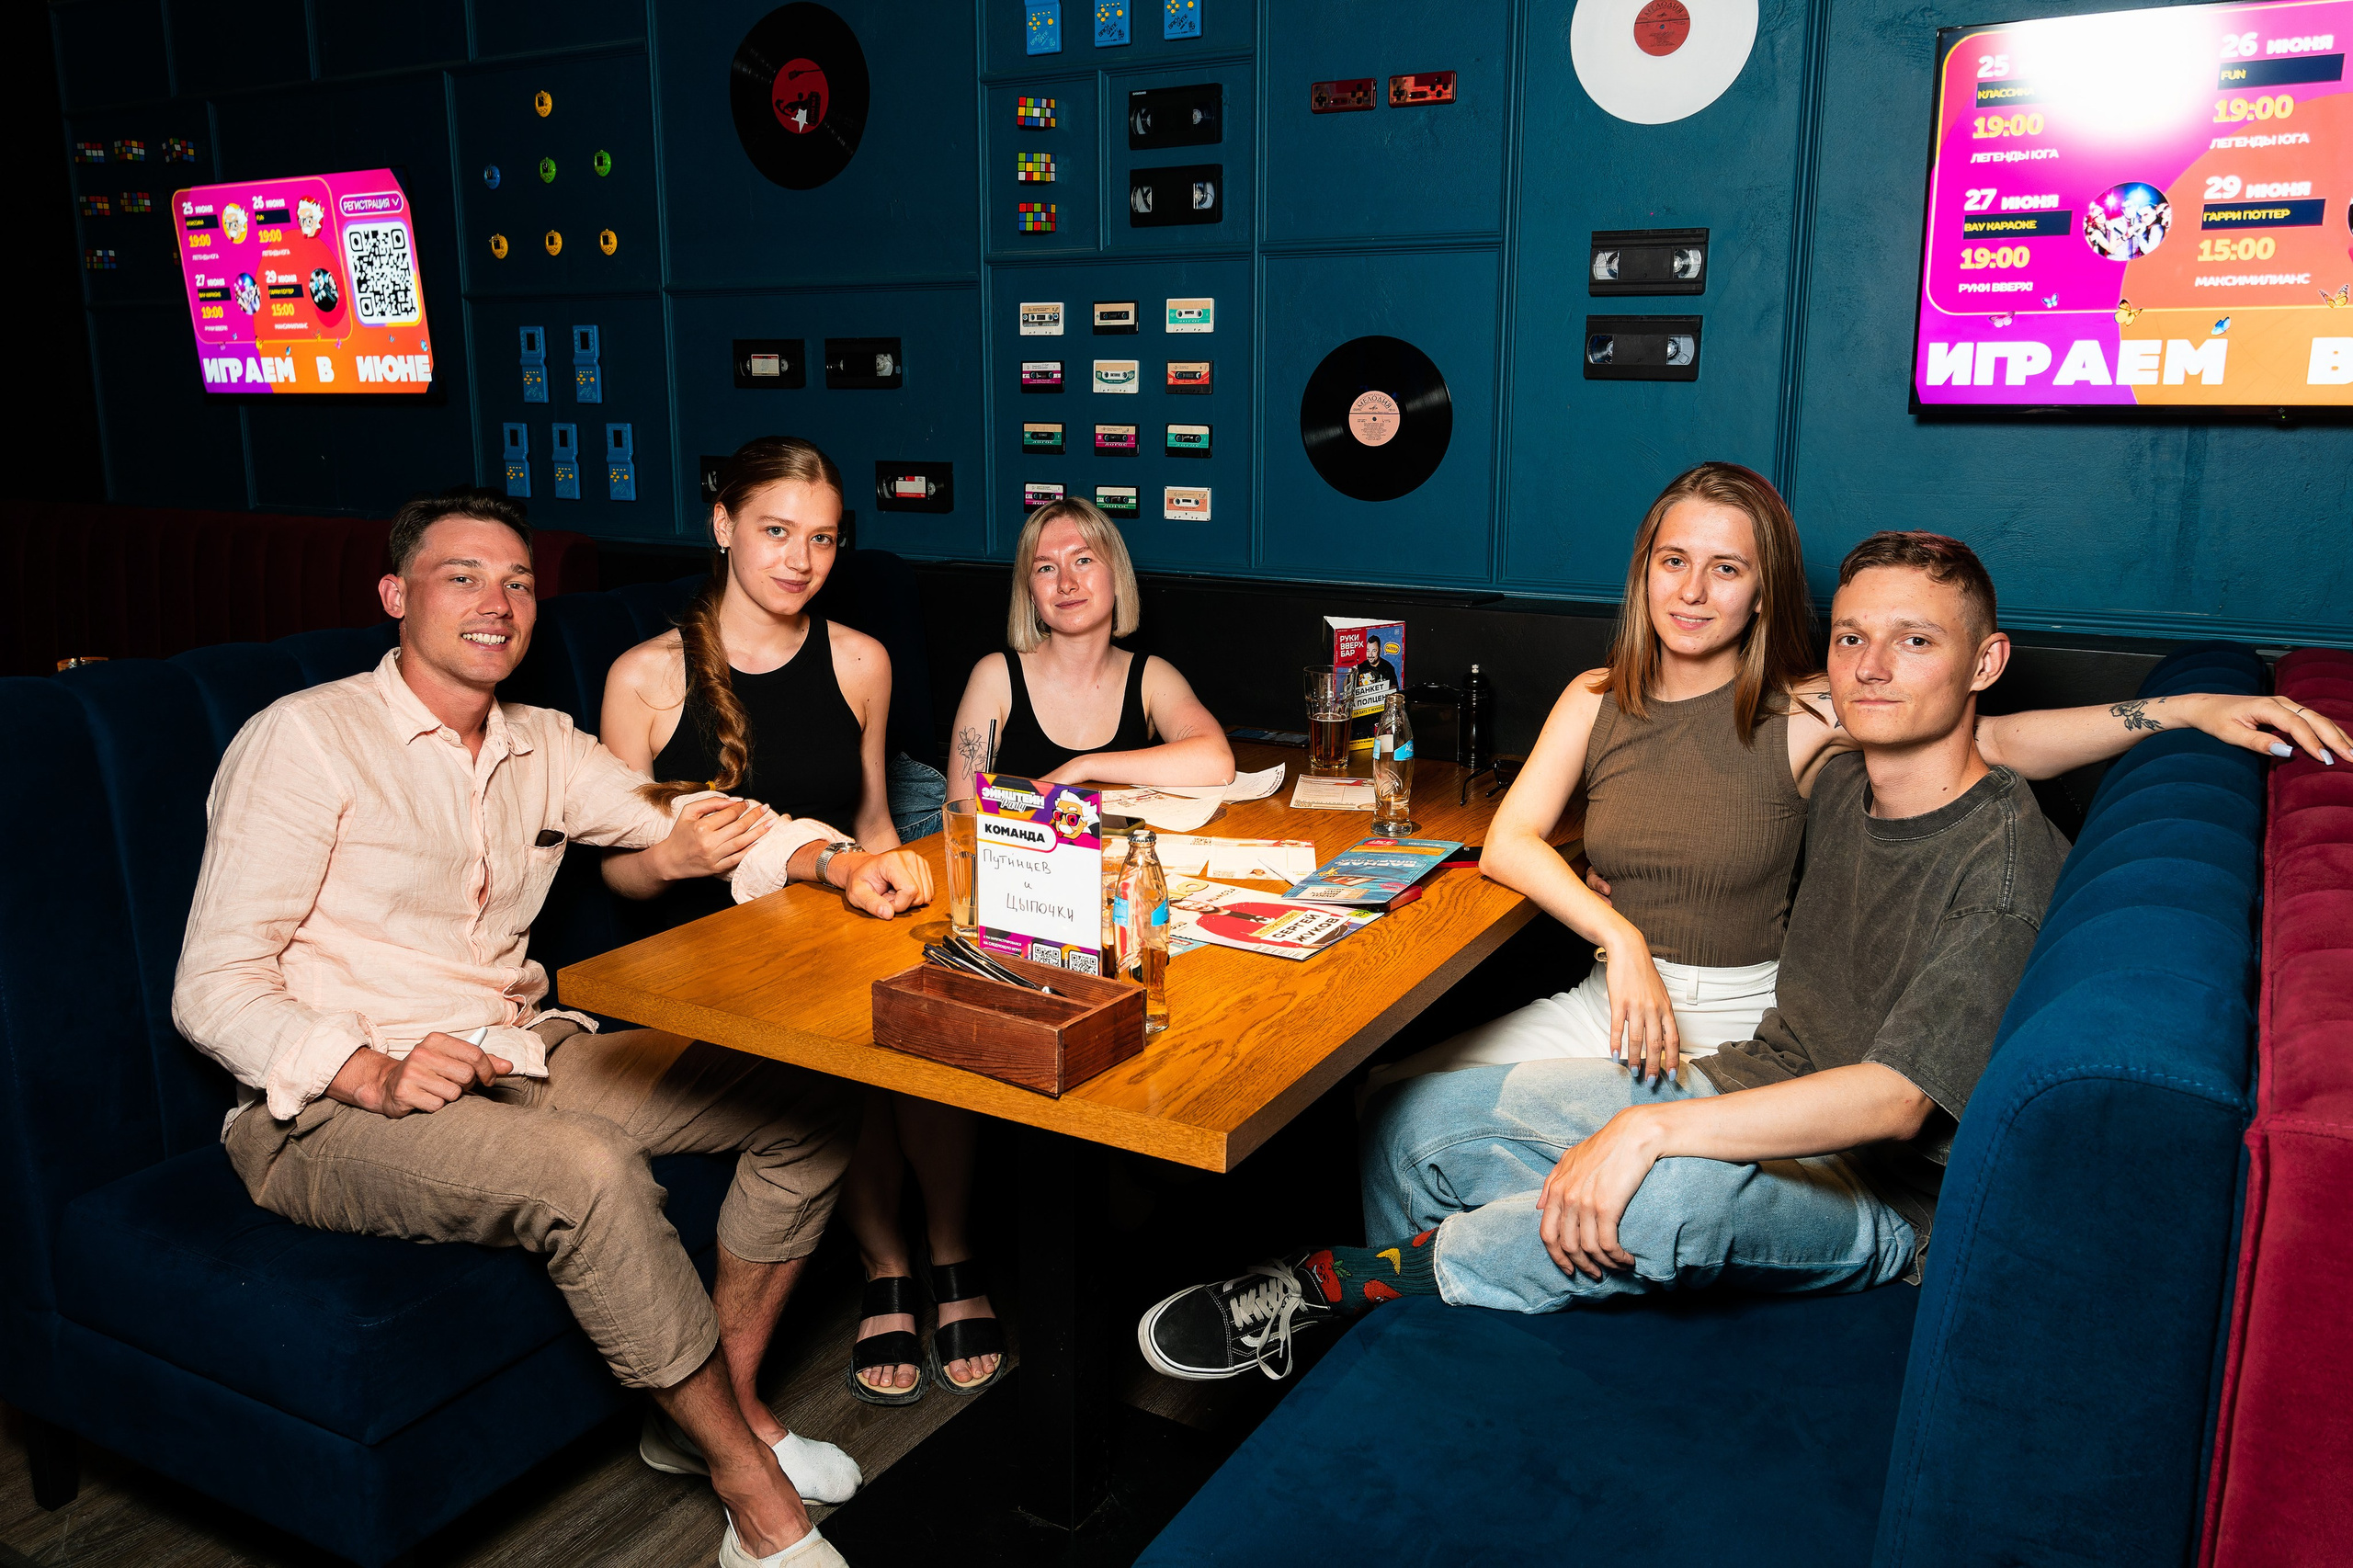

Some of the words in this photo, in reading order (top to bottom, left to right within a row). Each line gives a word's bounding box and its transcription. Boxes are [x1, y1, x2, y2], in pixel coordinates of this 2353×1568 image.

[2220, 31, 2258, 58] 26
[1977, 54, 2010, 78] 25
[2221, 69, 2246, 80] FUN
[1977, 87, 2036, 100] КЛАССИКА
[2213, 94, 2295, 123] 19:00
[1972, 112, 2045, 139] 19:00
[2210, 135, 2277, 149] ЛЕГЕНДЫ
[2279, 132, 2310, 145] ЮГА
[1970, 151, 2029, 164] ЛЕГЕНДЫ
[2030, 148, 2060, 160] ЮГА
[2203, 175, 2242, 200] 29
[252, 195, 264, 210] 26
[343, 198, 390, 211] РЕГИСТРАЦИЯ
[1963, 188, 1997, 211] 27
[182, 201, 193, 215] 25
[2203, 210, 2242, 222] ГАРРИ
[2243, 208, 2290, 220] ПОТТЕР
[1963, 222, 1986, 232] ВАУ
[1986, 220, 2037, 231] КАРАОКЕ
[188, 233, 211, 247] 19:00
[258, 228, 282, 244] 19:00
[2197, 236, 2276, 262] 15:00
[1960, 245, 2030, 269] 19:00
[195, 274, 205, 287] 27
[265, 269, 277, 283] 29
[2194, 273, 2312, 287] МАКСИМИЛИАНС
[1958, 283, 1990, 293] РУКИ
[1991, 281, 2034, 292] ВВЕРХ!
[201, 305, 223, 319] 19:00
[271, 302, 295, 317] 15:00
[202, 355, 296, 383] ИГРАЕМ
[315, 355, 335, 383] В
[356, 354, 432, 383] ИЮНЕ
[1926, 338, 2228, 386] ИГРАЕМ
[2307, 336, 2353, 386] В
[1356, 395, 1393, 409] МЕЛОДИЯ
[1339, 633, 1359, 642] РУКИ
[1340, 641, 1364, 650] ВВЕРХ
[1340, 649, 1356, 658] БАР
[1355, 683, 1384, 696] БАНКЕТ
[1357, 694, 1386, 707] ПОЛЦЕН
[981, 786, 1045, 806] ЭЙНШТЕЙН
[1000, 798, 1027, 813] Party
[984, 824, 1046, 843] КОМАНДА
[1272, 914, 1321, 938] СЕРГЕЙ
[1292, 917, 1341, 942] ЖУКОВ
